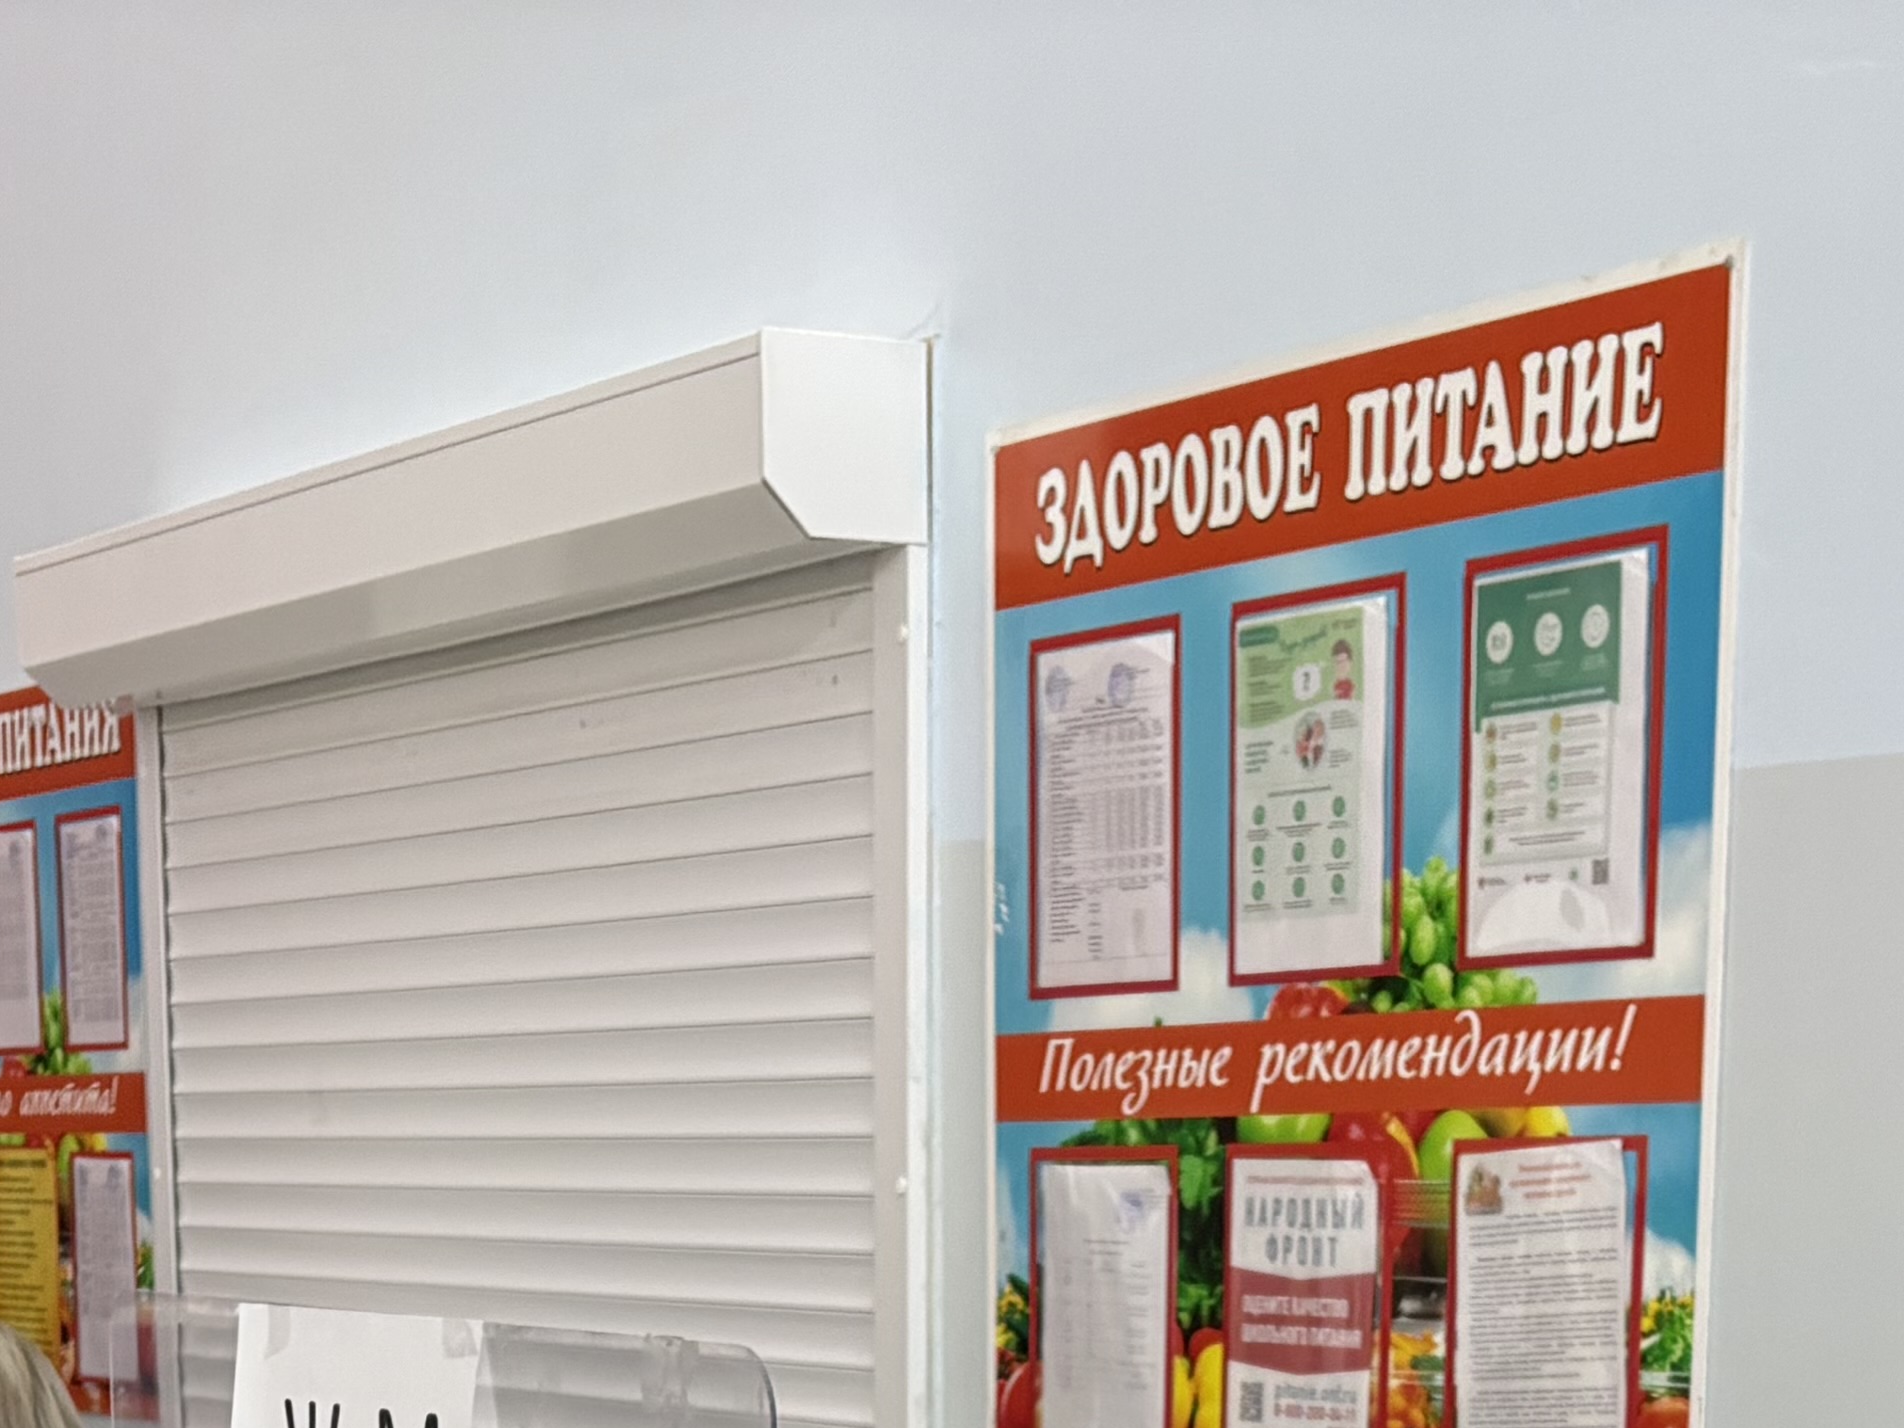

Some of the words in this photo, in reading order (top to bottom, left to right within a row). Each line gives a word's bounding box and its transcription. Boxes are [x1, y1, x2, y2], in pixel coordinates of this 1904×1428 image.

[1035, 402, 1322, 573] ЗДОРОВОЕ
[1345, 321, 1665, 501] ПИТАНИЕ
[1040, 1038, 1232, 1116] Полезные
[1250, 1005, 1637, 1113] рекомендации!
[20, 1075, 119, 1117] аппетита!
[1245, 1193, 1364, 1231] НАРОДНЫЙ
[1265, 1233, 1337, 1268] ФРОНТ
